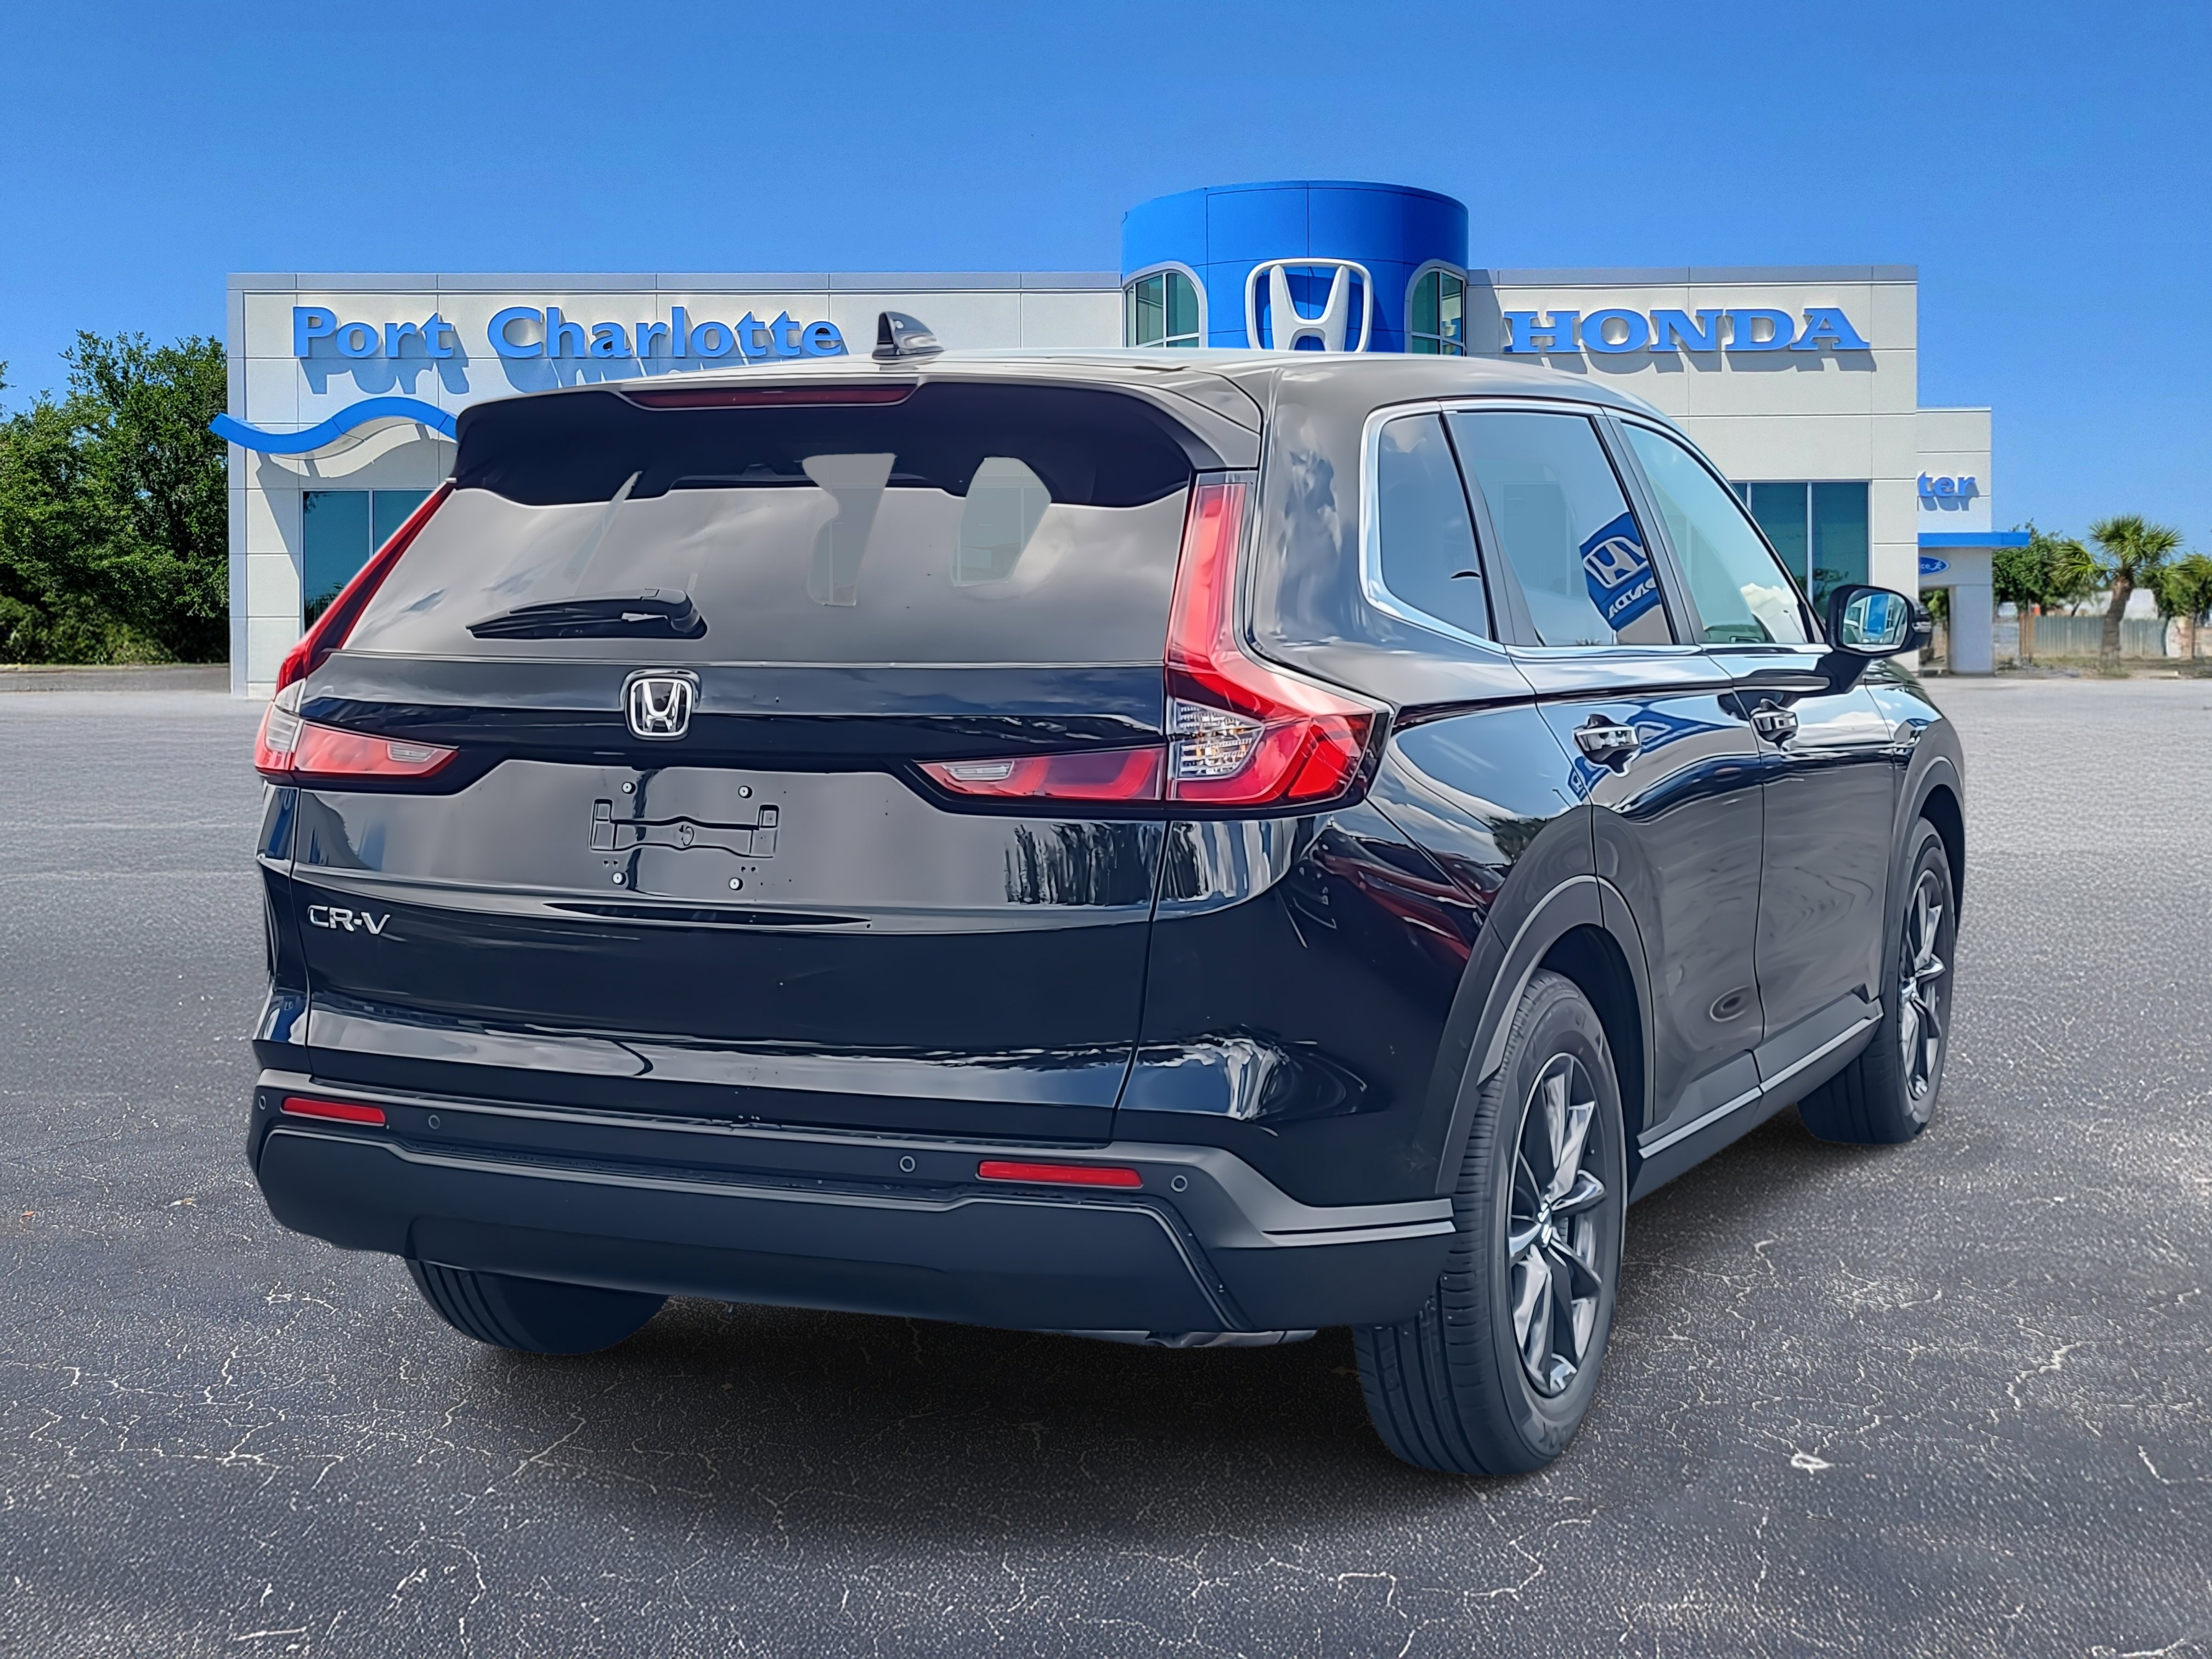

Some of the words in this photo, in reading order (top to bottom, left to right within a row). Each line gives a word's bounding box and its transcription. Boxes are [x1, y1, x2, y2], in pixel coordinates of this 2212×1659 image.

[293, 306, 454, 358] Port
[487, 306, 842, 358] Charlotte
[1504, 308, 1870, 352] HONDA
[1917, 471, 1976, 497] ter
[307, 905, 391, 934] CR-V
